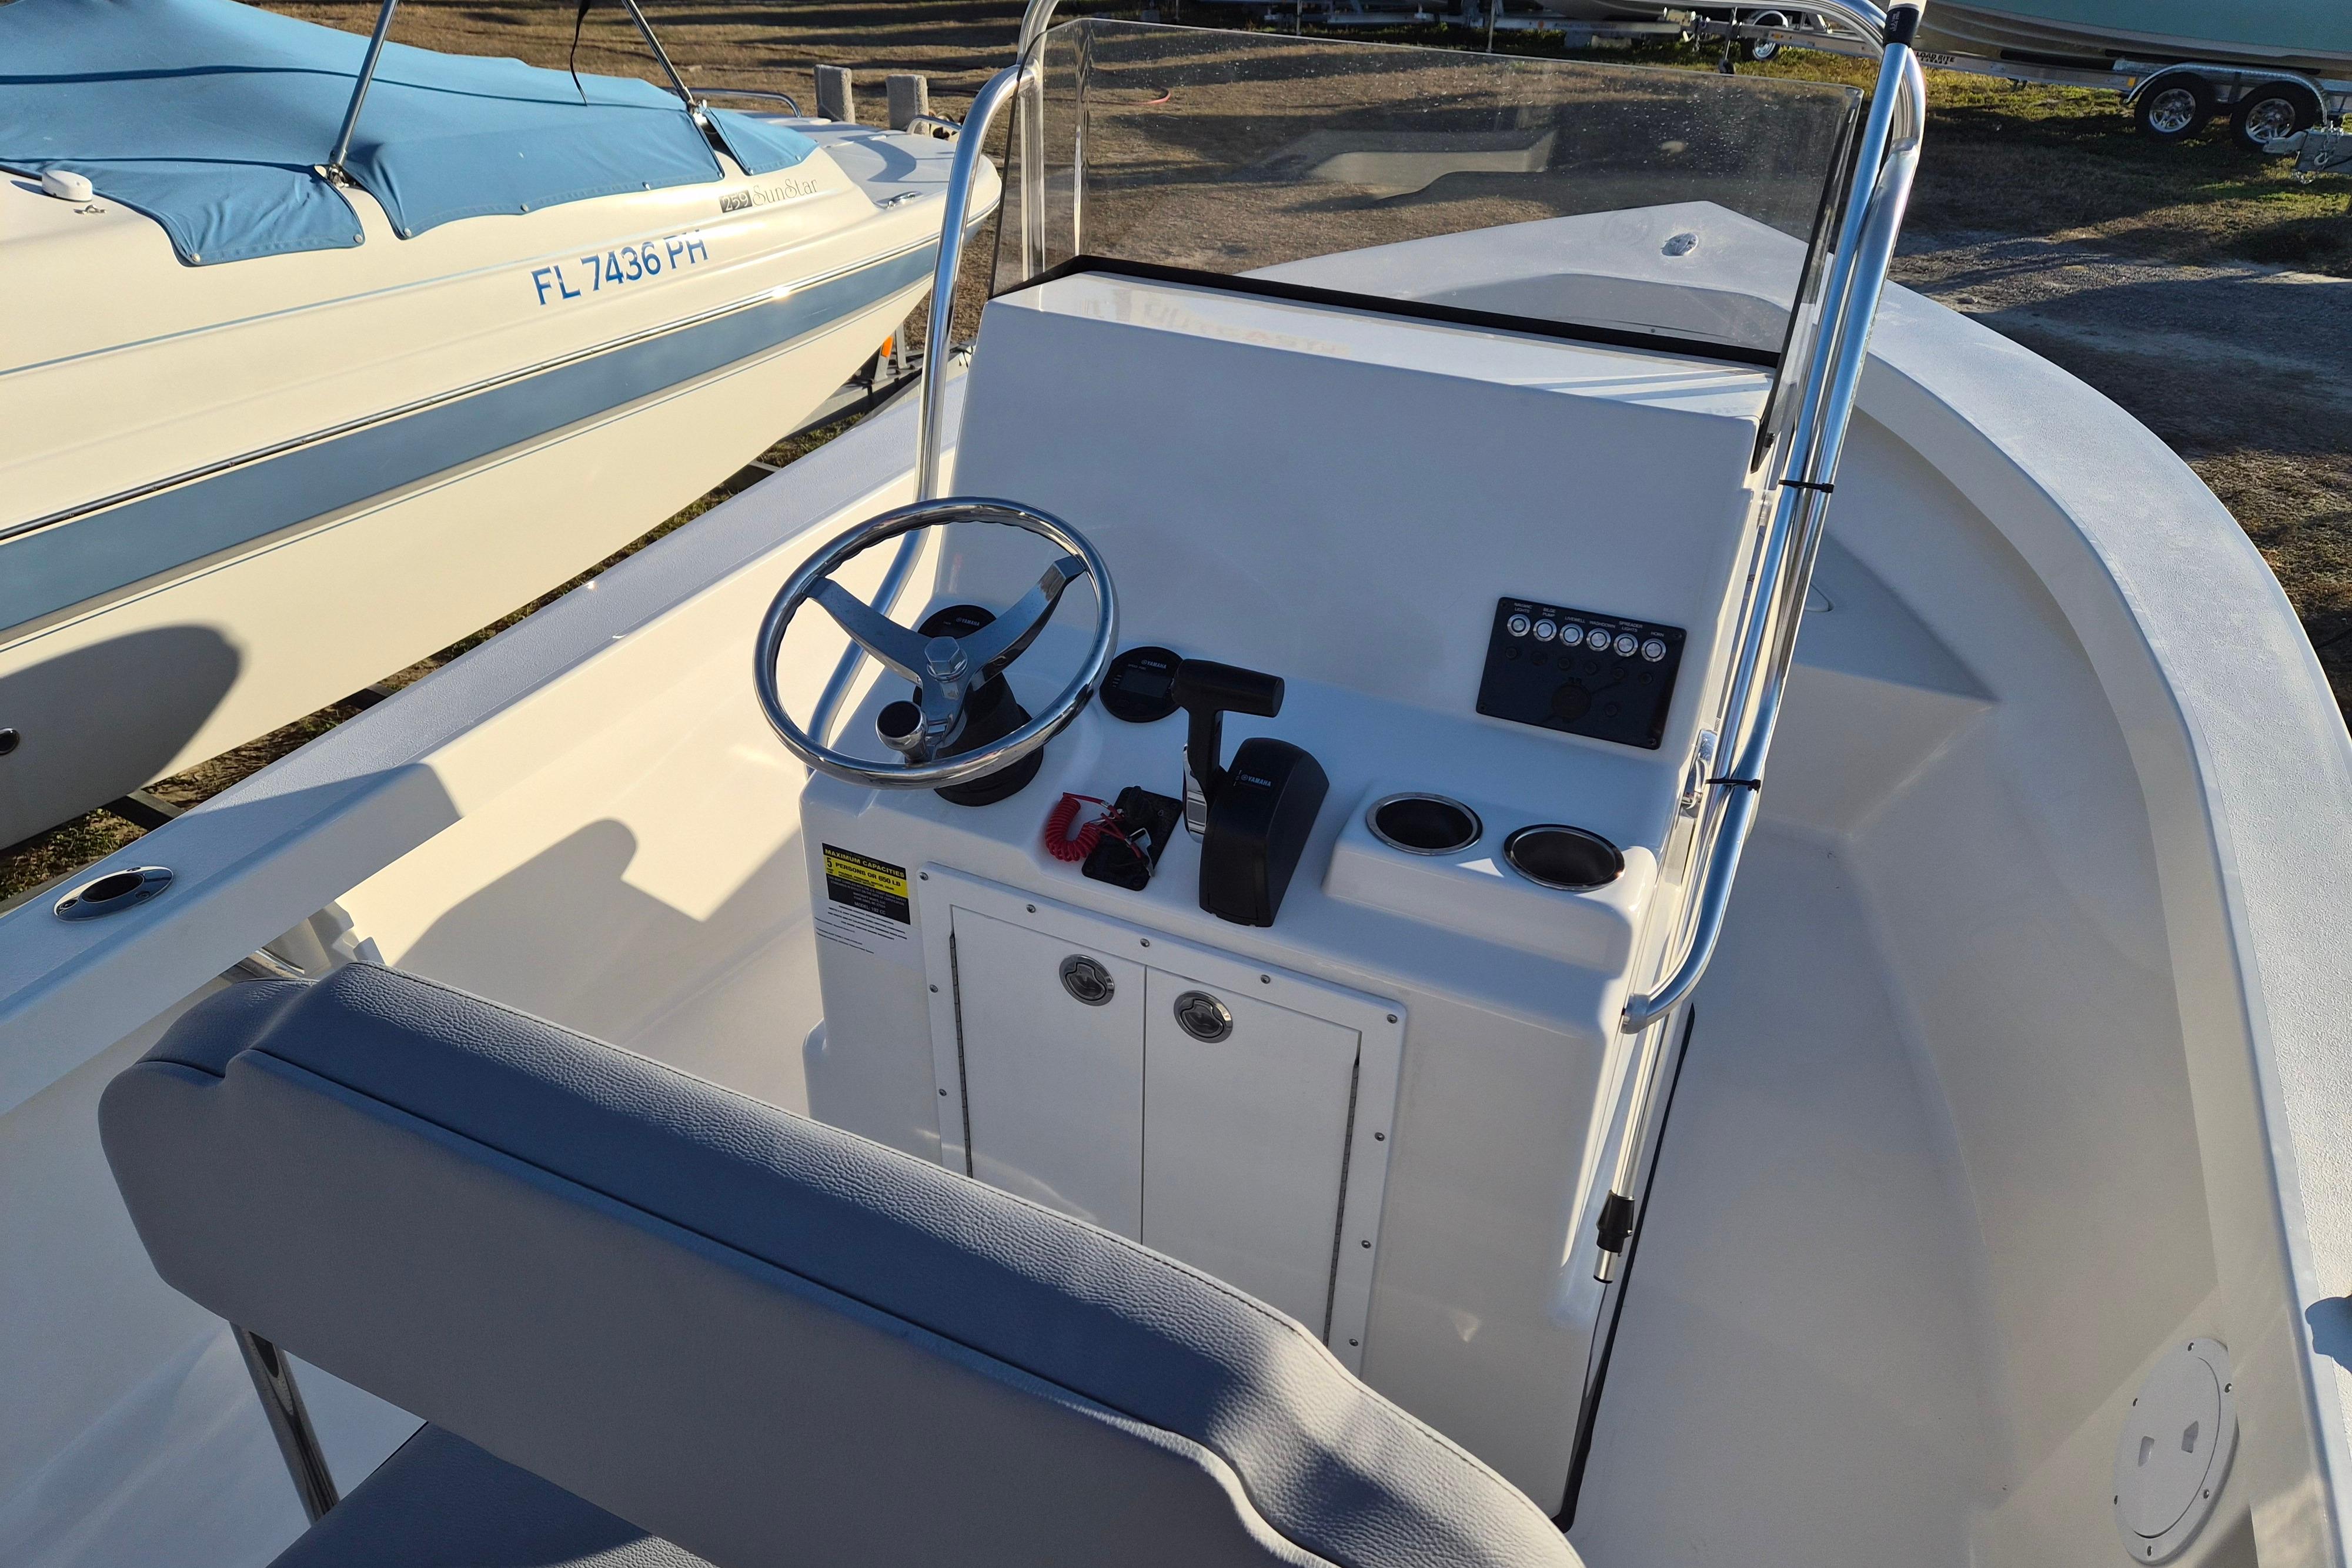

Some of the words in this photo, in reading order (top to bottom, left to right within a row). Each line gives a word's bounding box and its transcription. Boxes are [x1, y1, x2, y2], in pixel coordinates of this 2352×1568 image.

[721, 192, 749, 211] 259
[752, 178, 818, 206] SunStar
[531, 266, 582, 305] FL
[580, 241, 662, 292] 7436
[662, 229, 709, 269] PH
[961, 618, 980, 626] YAMAHA
[1147, 661, 1167, 670] YAMAHA
[1248, 775, 1271, 787] YAMAHA
[825, 848, 861, 864] MAXIMUM
[862, 860, 905, 878] CAPACITIES
[826, 857, 833, 868] 5
[836, 862, 866, 876] PERSONS
[867, 871, 877, 880] OR
[878, 875, 891, 884] 650
